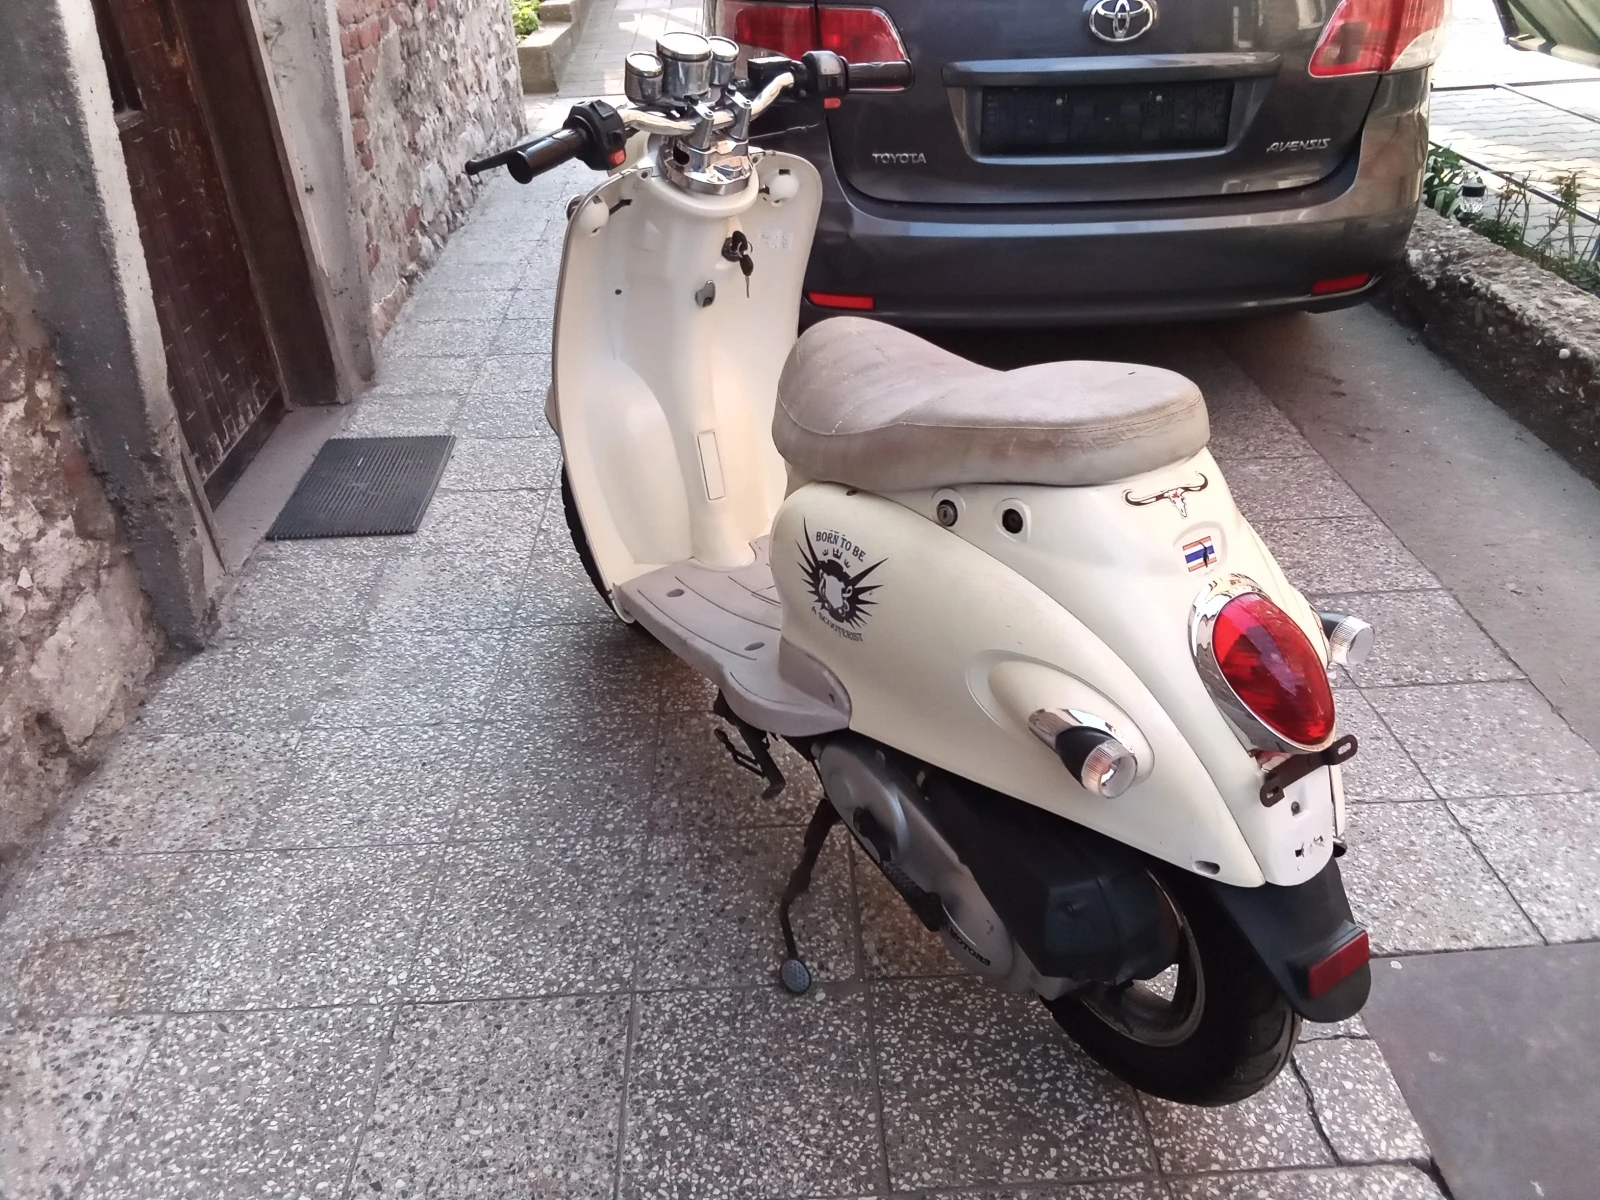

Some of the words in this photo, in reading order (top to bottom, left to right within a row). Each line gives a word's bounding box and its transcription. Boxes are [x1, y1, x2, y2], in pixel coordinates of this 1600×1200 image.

[1265, 138, 1331, 154] AVENSIS
[871, 152, 927, 164] TOYOTA
[815, 531, 839, 545] BORN
[840, 537, 852, 551] TO
[852, 546, 866, 562] BE
[811, 606, 817, 615] A
[818, 612, 864, 642] SCOOTERIST
